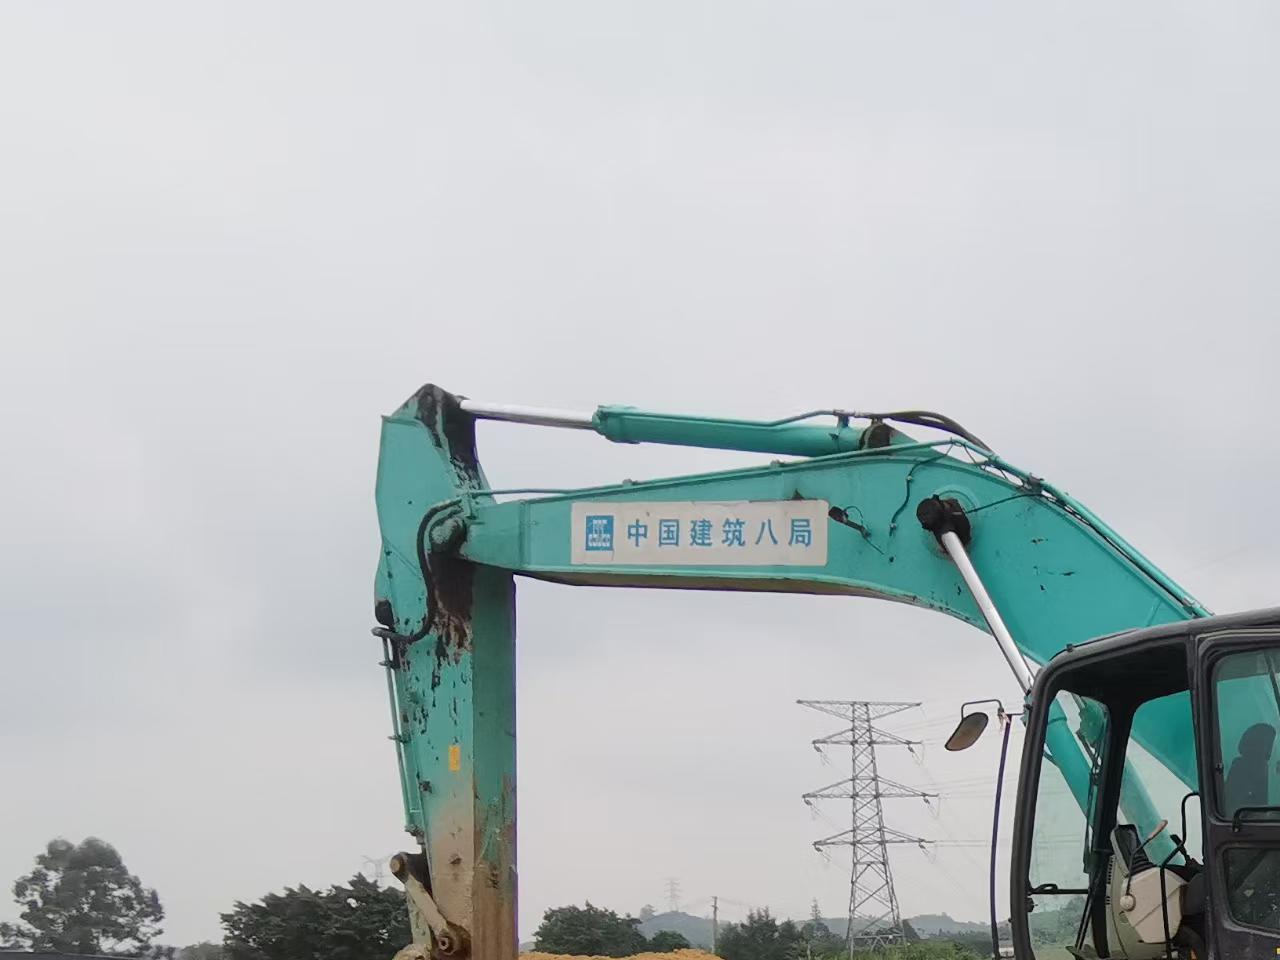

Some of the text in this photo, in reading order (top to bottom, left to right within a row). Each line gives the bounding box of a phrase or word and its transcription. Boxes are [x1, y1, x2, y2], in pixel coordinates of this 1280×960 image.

[627, 518, 812, 547] 中国建筑八局
